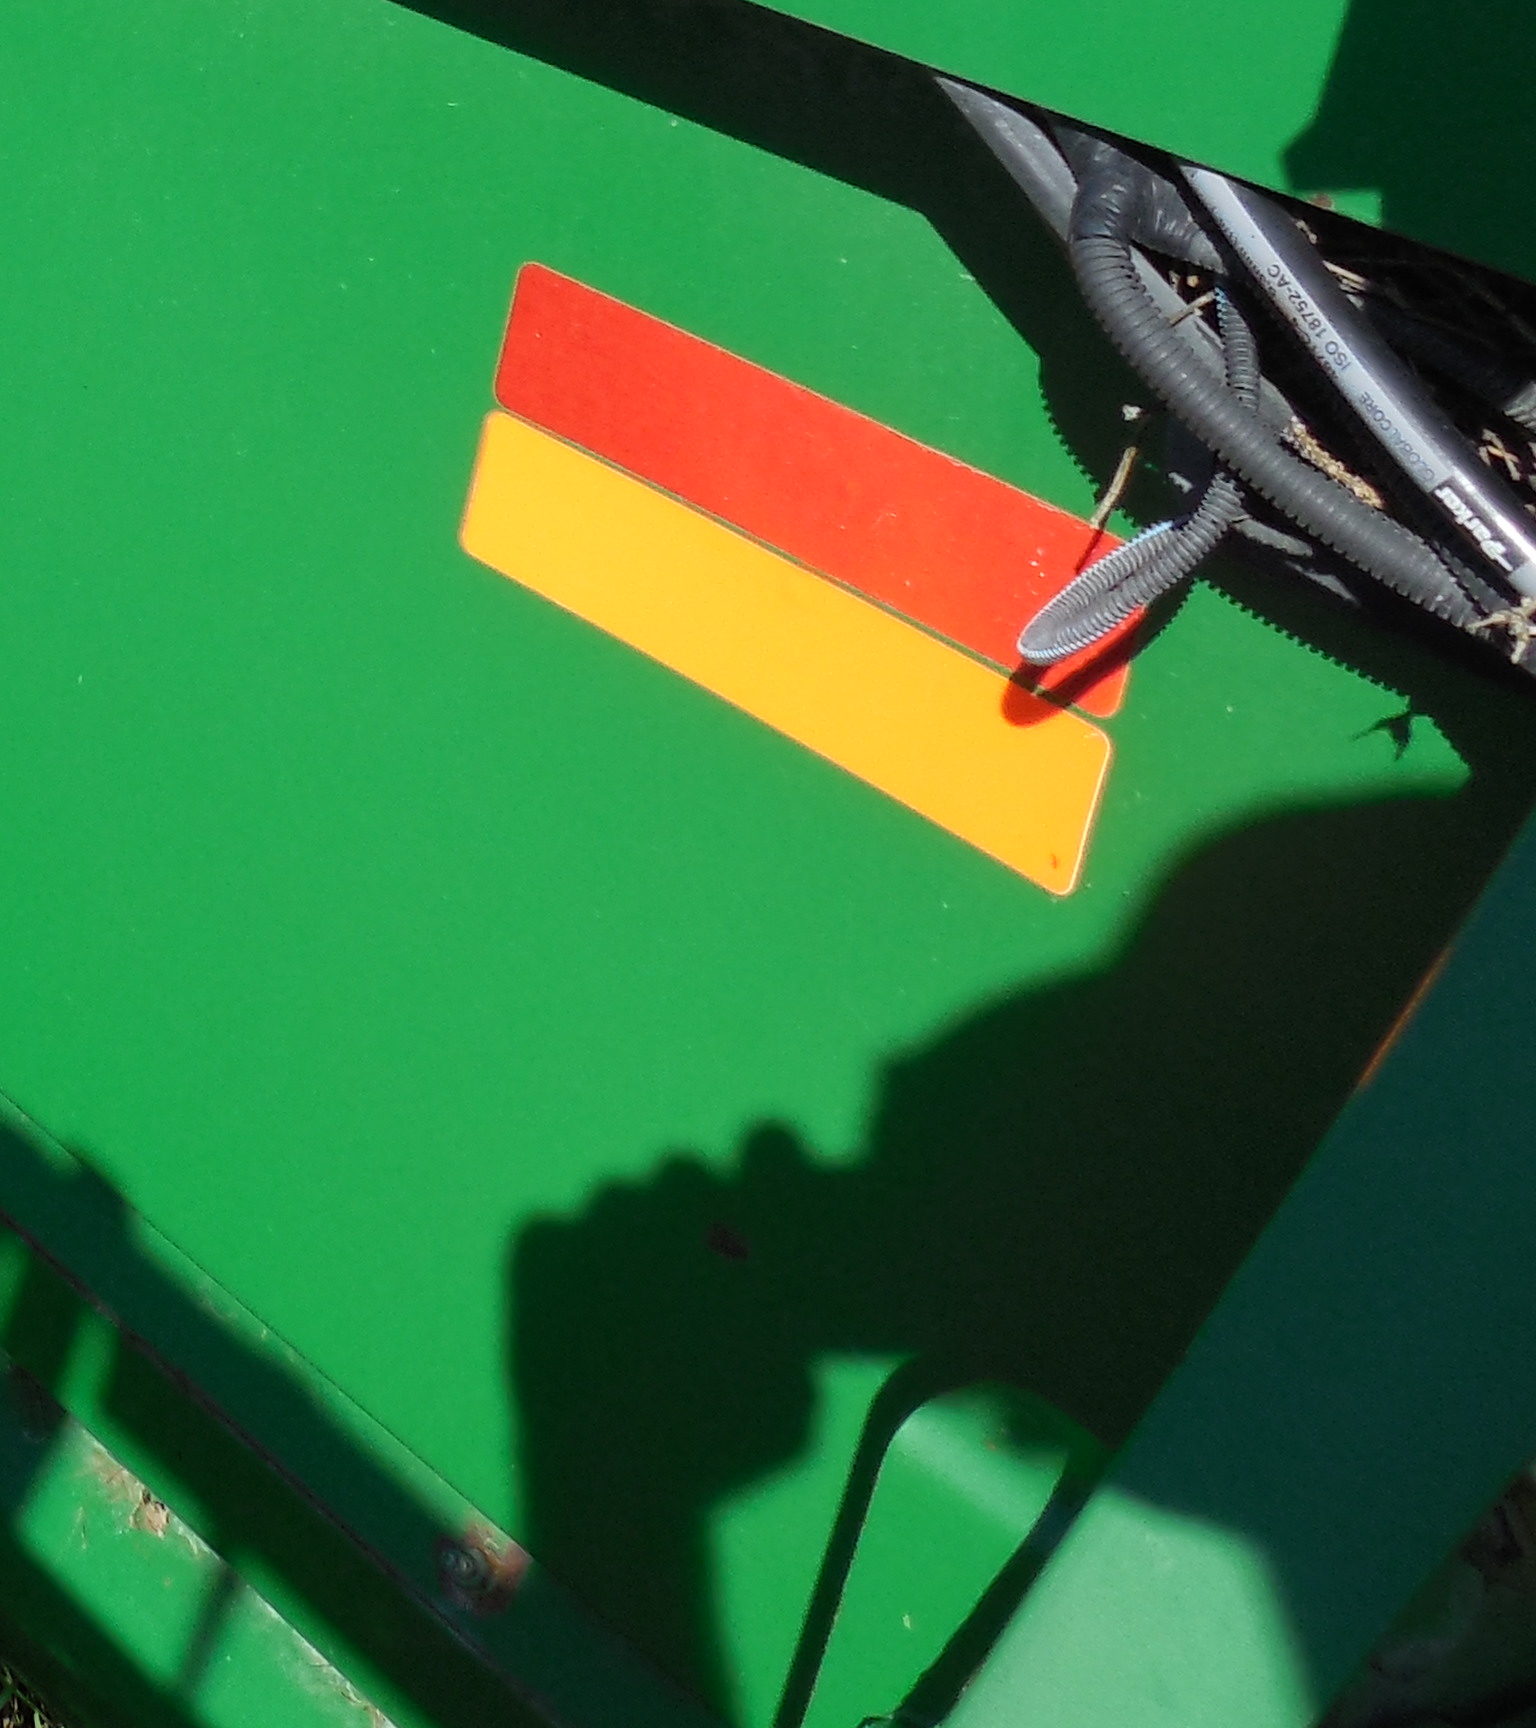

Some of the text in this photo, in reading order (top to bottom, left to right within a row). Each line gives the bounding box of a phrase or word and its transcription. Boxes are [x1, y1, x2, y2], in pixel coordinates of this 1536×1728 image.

[1266, 261, 1326, 338] 18752-AC
[1325, 341, 1352, 370] ISO
[1433, 484, 1507, 561] Parker
